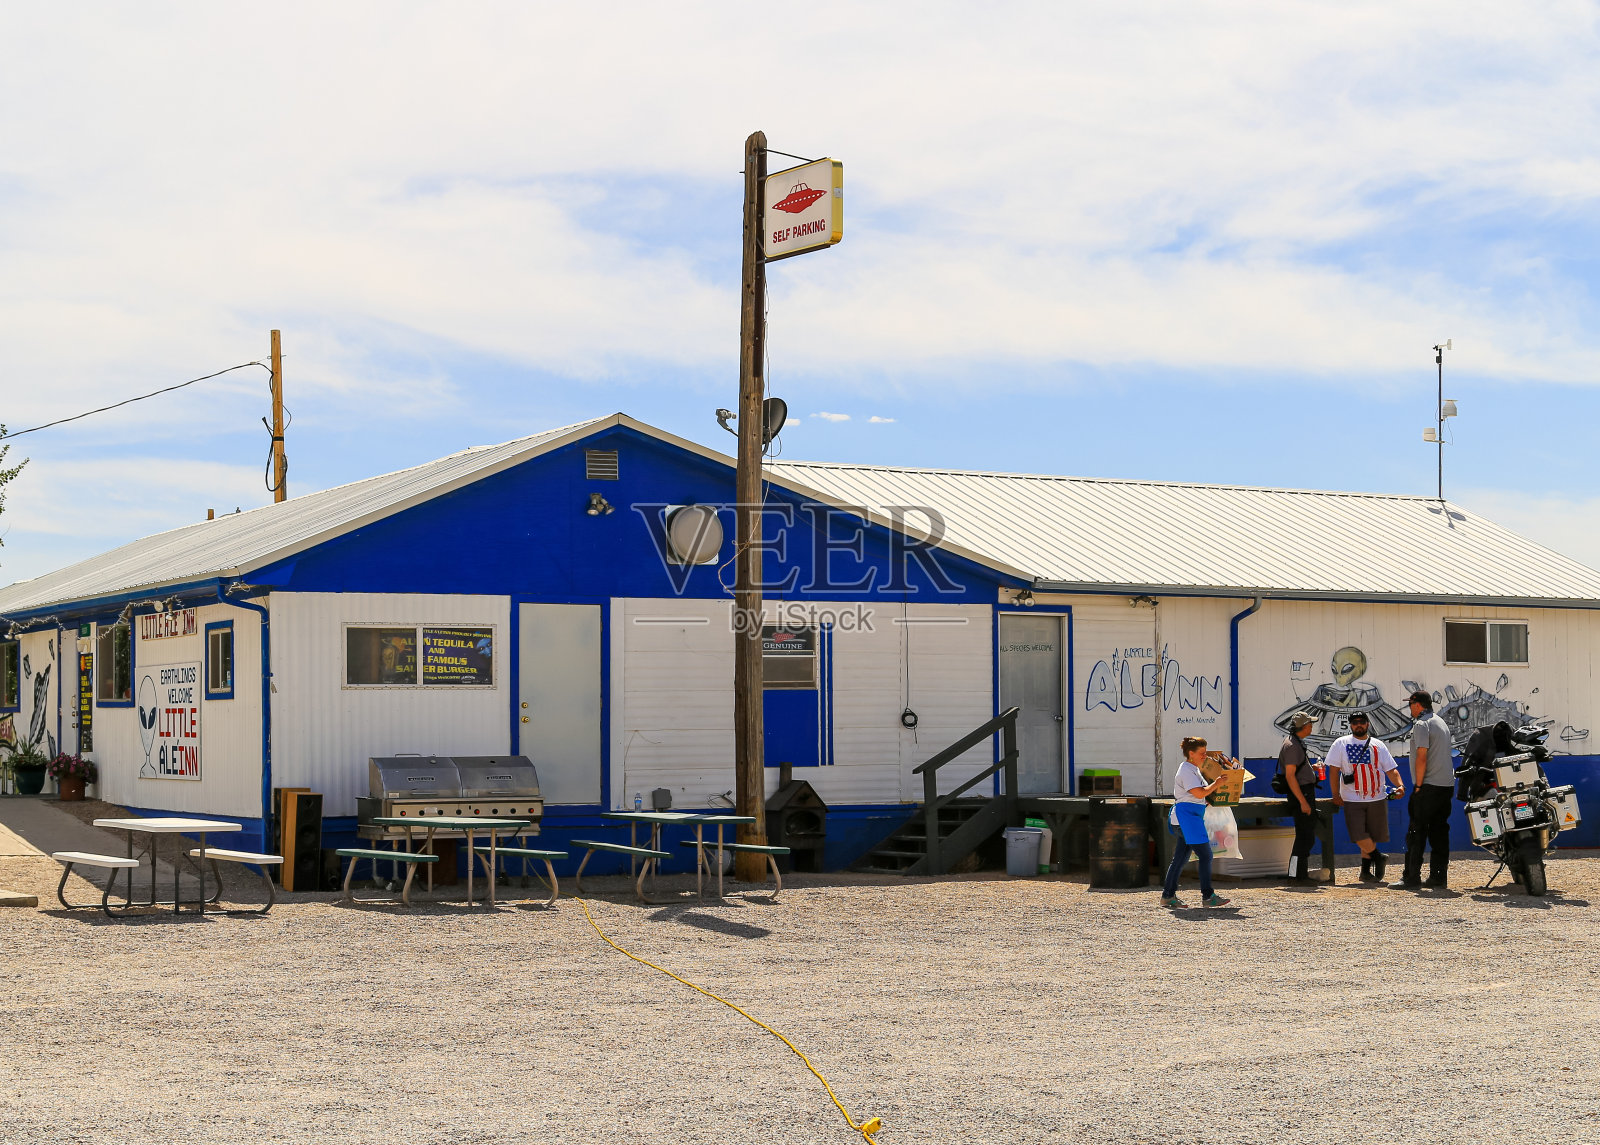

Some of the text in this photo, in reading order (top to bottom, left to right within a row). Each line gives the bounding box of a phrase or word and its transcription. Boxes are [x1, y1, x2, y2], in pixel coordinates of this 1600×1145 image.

[772, 219, 826, 243] SELF PARKING
[141, 613, 163, 640] LITTLE
[433, 638, 474, 649] TEQUILA
[763, 642, 803, 650] GENUINE
[428, 647, 446, 655] AND
[428, 656, 468, 666] FAMOUS
[160, 667, 196, 685] EARTHLINGS
[437, 667, 478, 675] BURGER
[168, 688, 193, 704] WELCOME
[159, 708, 197, 738] LITTLE
